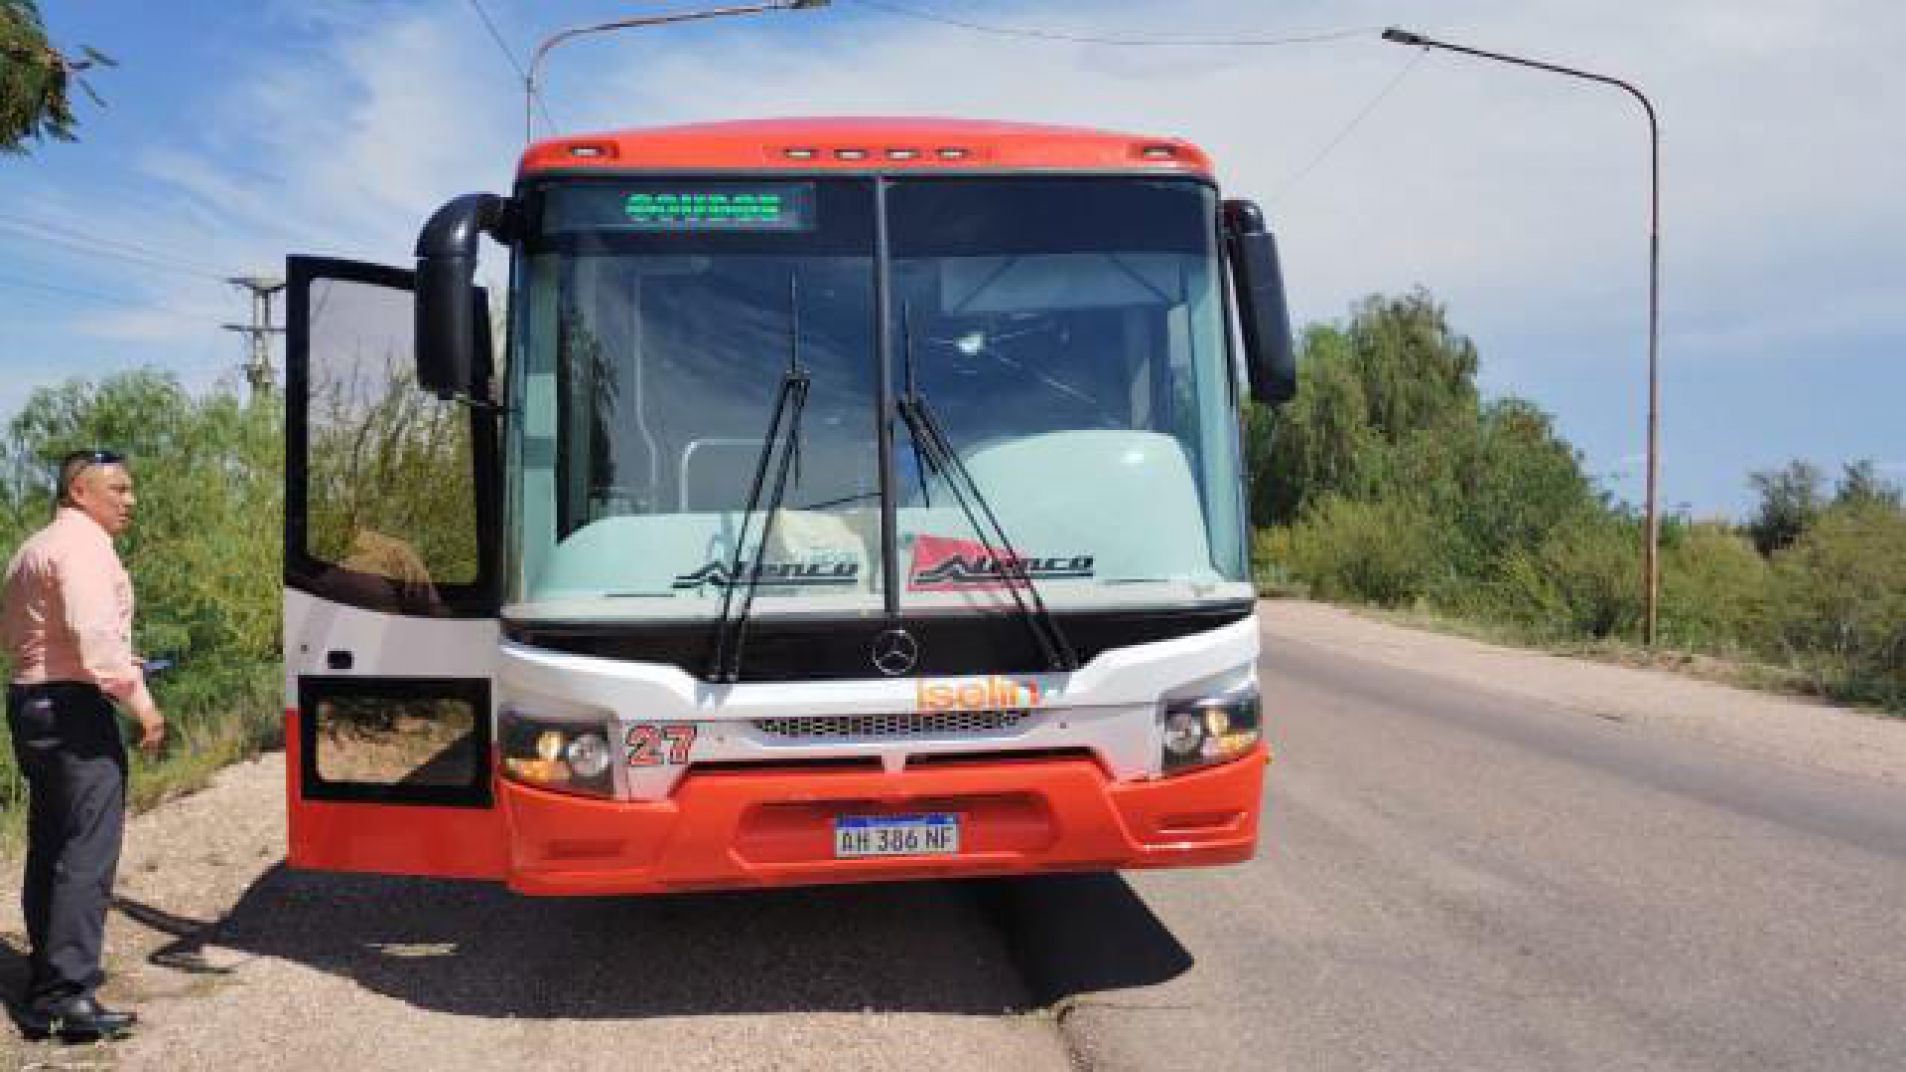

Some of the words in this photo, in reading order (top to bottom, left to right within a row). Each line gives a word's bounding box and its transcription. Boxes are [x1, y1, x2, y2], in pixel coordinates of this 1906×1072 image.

[624, 722, 698, 766] 27
[842, 830, 870, 852] AH
[877, 829, 918, 852] 386
[925, 826, 954, 849] NF
